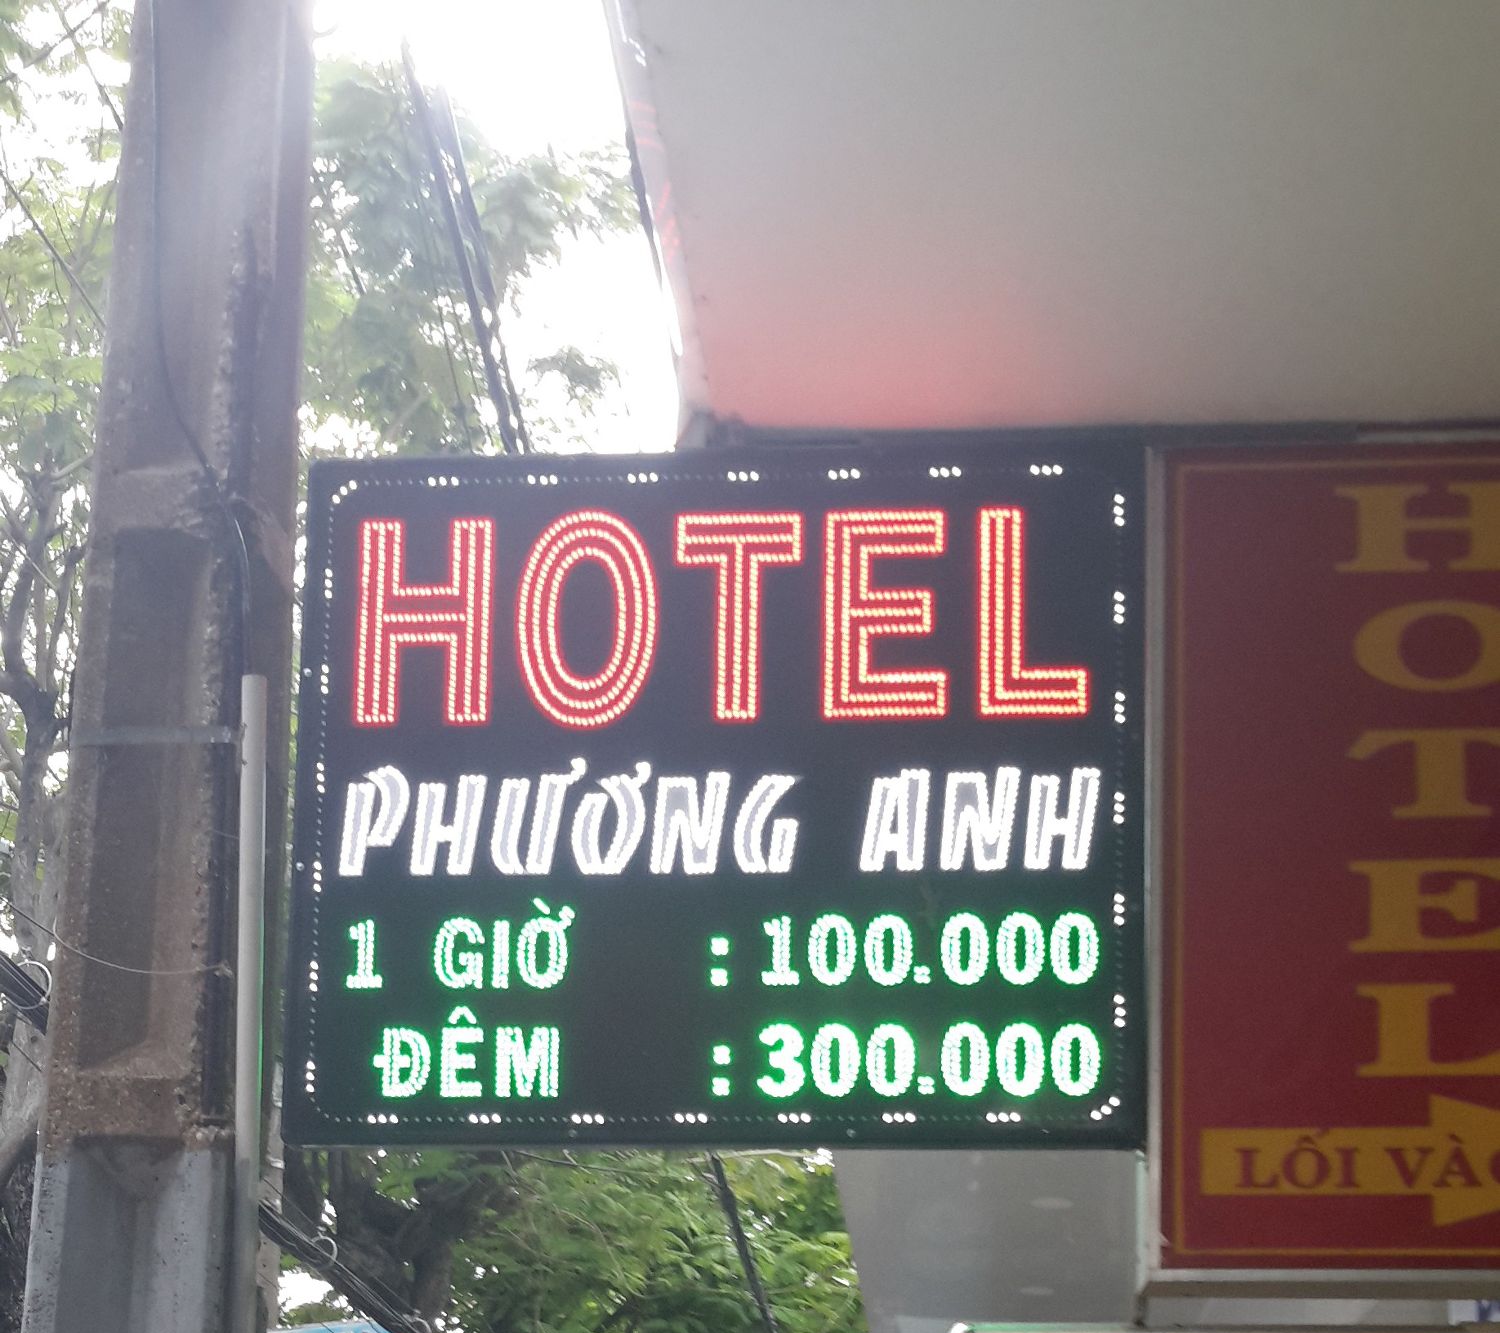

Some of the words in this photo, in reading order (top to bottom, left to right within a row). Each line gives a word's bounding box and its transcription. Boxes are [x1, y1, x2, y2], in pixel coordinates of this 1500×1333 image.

[353, 510, 1088, 728] HOTEL
[338, 758, 800, 877] PHƯƠNG
[858, 766, 1102, 872] ANH
[1334, 483, 1500, 1077] HOTEL
[343, 917, 384, 989] 1
[431, 897, 577, 990] GIỜ
[373, 1005, 560, 1099] ĐÊM
[1234, 1122, 1361, 1190] LỐI
[1384, 1134, 1500, 1190] VÀ
